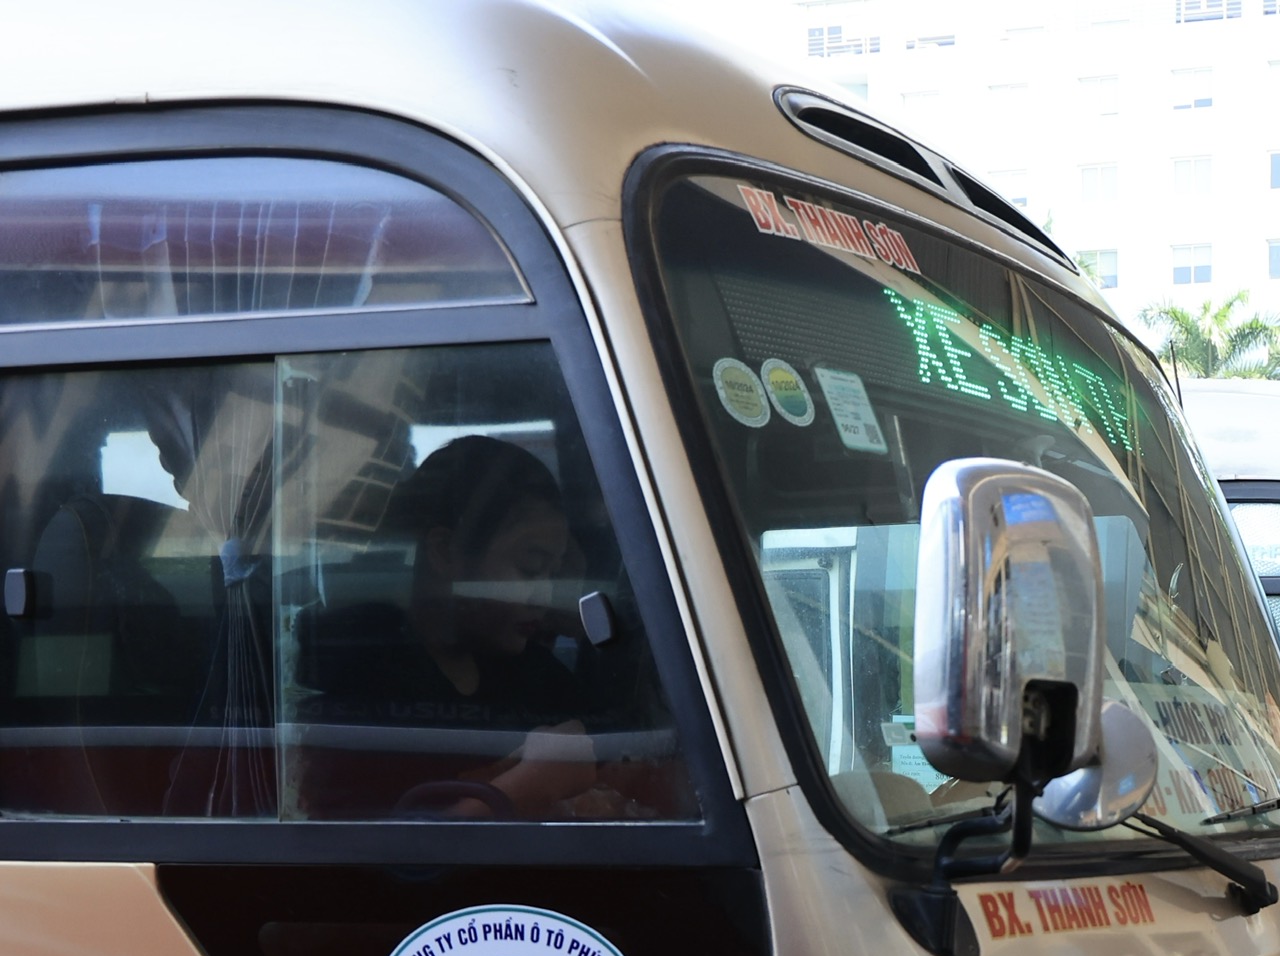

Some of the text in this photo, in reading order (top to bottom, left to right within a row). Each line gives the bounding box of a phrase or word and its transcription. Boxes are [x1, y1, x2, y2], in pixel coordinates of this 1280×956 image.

[738, 185, 921, 275] BX. THANH SƠN
[883, 288, 992, 400] XE
[434, 932, 454, 955] TY
[457, 918, 479, 946] CỔ
[482, 916, 526, 942] PHẦN
[530, 922, 541, 944] Ô
[546, 928, 565, 950] TÔ
[977, 880, 1156, 940] BX. THANH SƠN
